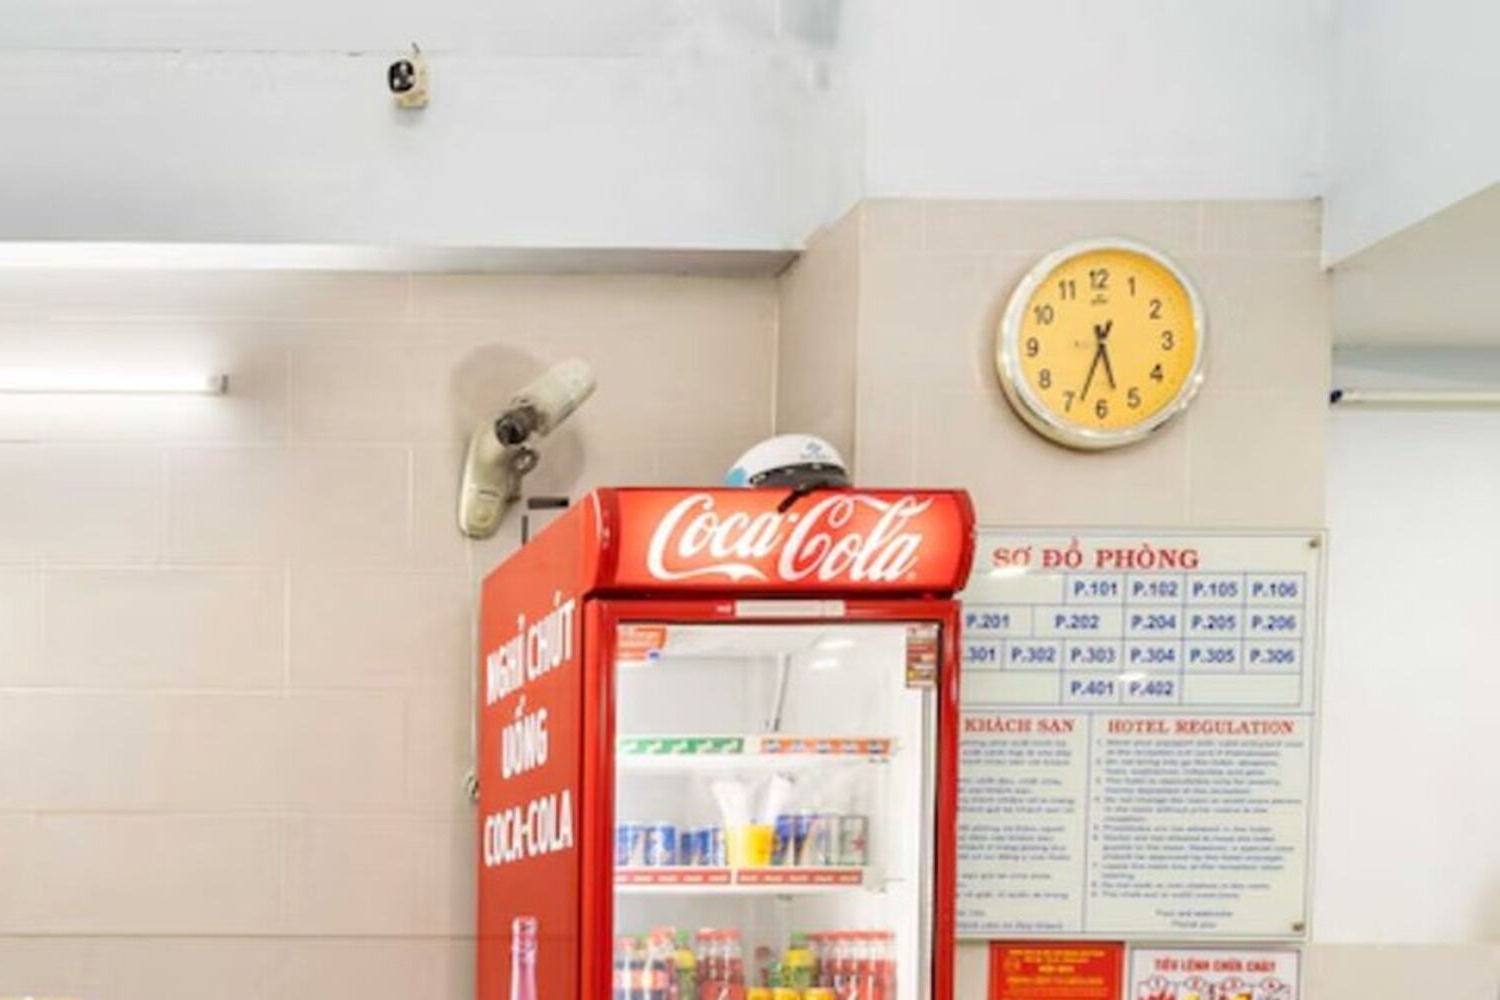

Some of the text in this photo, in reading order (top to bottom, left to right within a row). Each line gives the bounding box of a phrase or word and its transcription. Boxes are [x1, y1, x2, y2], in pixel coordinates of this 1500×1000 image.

[1089, 268, 1109, 290] 12
[1128, 276, 1136, 296] 1
[1058, 280, 1076, 300] 11
[1034, 304, 1054, 325] 10
[1149, 299, 1162, 320] 2
[1026, 337, 1038, 357] 9
[1161, 330, 1174, 350] 3
[1039, 369, 1051, 389] 8
[1150, 364, 1163, 382] 4
[1063, 391, 1075, 412] 7
[1127, 387, 1141, 408] 5
[1095, 399, 1107, 419] 6
[646, 493, 934, 582] Coca-Cola
[993, 546, 1032, 567] SƠ
[1095, 543, 1199, 569] PHÒNG
[1074, 581, 1297, 598] P.101 P.102 P.105 P.106
[966, 614, 1296, 630] P.201 P.202 P.204 P.205 P.206
[963, 647, 1295, 664] .301 P.302 P.303 P.304 P.305 P.306
[1071, 680, 1174, 696] P.401 P.402
[1108, 719, 1295, 735] HOTEL REGULATION
[483, 789, 574, 867] COCA-COLA
